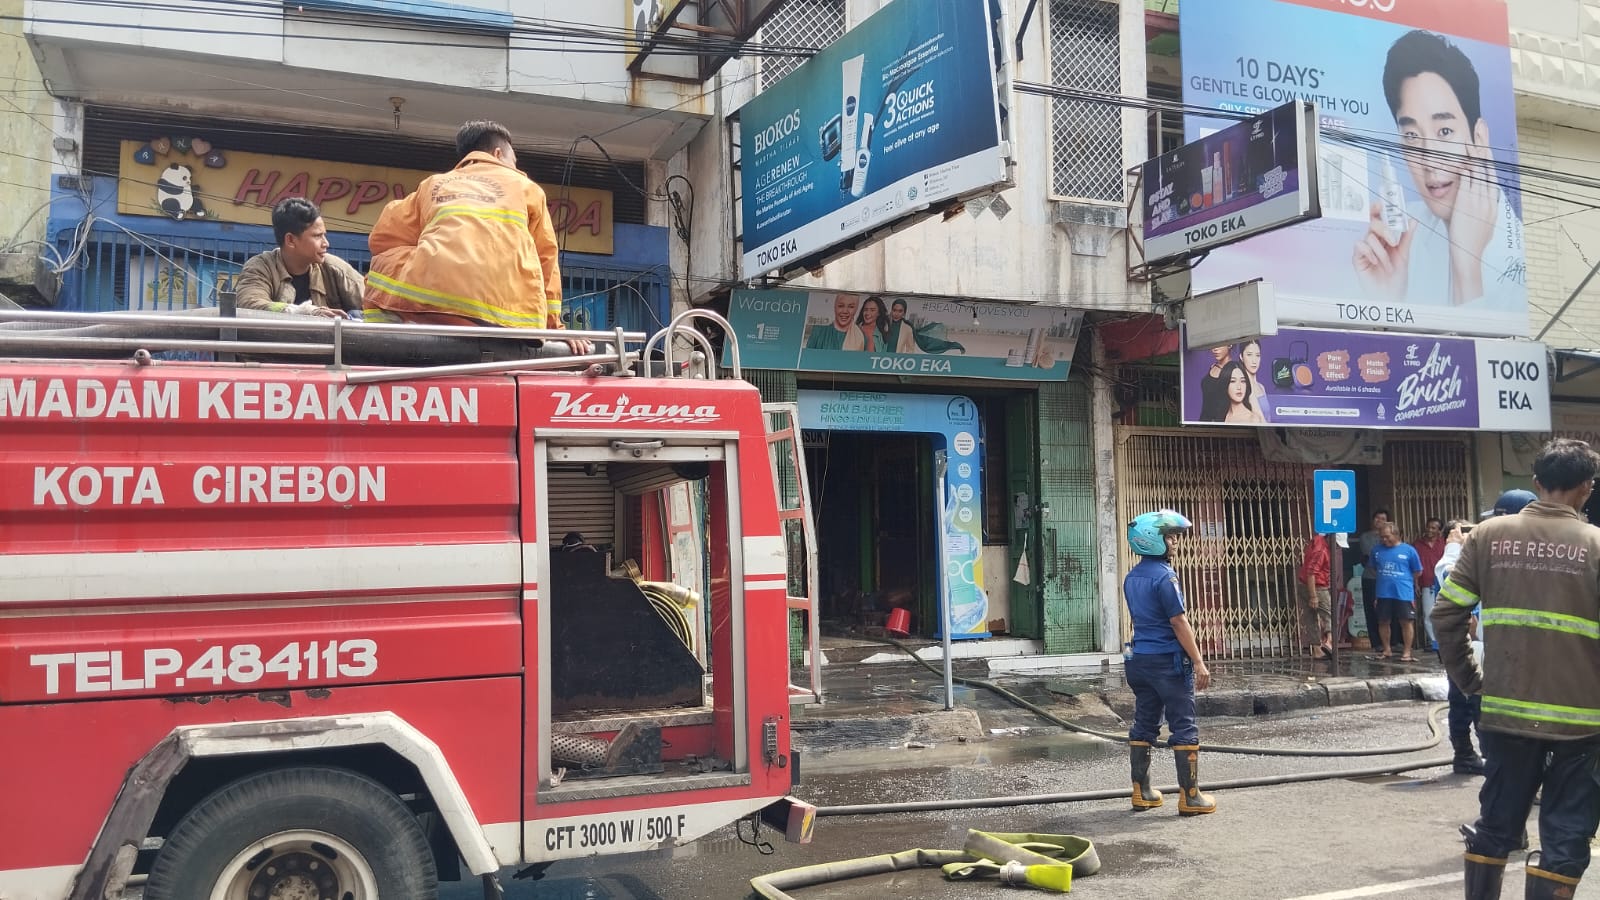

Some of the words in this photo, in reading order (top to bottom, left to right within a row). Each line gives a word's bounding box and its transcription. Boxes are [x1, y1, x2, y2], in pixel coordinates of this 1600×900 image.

[1236, 57, 1259, 79] 10
[883, 93, 896, 129] 3
[897, 79, 934, 110] QUICK
[1190, 75, 1248, 97] GENTLE
[1252, 85, 1296, 103] GLOW
[1301, 92, 1336, 110] WITH
[1341, 100, 1369, 115] YOU
[896, 96, 934, 125] ACTIONS
[754, 108, 801, 156] BIOKOS
[926, 123, 940, 134] age
[1184, 223, 1218, 245] TOKO
[1221, 214, 1247, 234] EKA
[1506, 222, 1514, 249] HYUN
[756, 246, 779, 268] TOKO
[780, 238, 798, 257] EKA
[738, 295, 801, 314] Wardah
[1335, 303, 1381, 321] TOKO
[1385, 307, 1415, 324] EKA
[870, 356, 916, 371] TOKO
[919, 358, 952, 373] EKA
[1326, 371, 1345, 379] Effect
[1418, 342, 1452, 382] Air
[1488, 360, 1539, 381] TOKO
[198, 381, 478, 422] KEBAKARAN
[1325, 385, 1351, 393] Available
[1395, 364, 1462, 411] Brush
[1498, 390, 1532, 410] EKA
[551, 392, 720, 421] Kajama
[820, 403, 849, 414] SKIN
[852, 405, 904, 416] BARRIER
[1394, 407, 1425, 422] COMPACT
[1425, 398, 1467, 418] FOUNDATION
[33, 466, 164, 505] KOTA
[193, 465, 386, 503] CIREBON
[1323, 480, 1349, 523] P
[1490, 540, 1521, 556] FIRE
[1526, 541, 1588, 563] RESCUE
[30, 638, 378, 694] TELP.484113
[545, 825, 576, 851] CFT
[580, 821, 616, 848] 3000
[620, 819, 634, 843] W
[646, 815, 673, 841] 500
[677, 814, 686, 837] F
